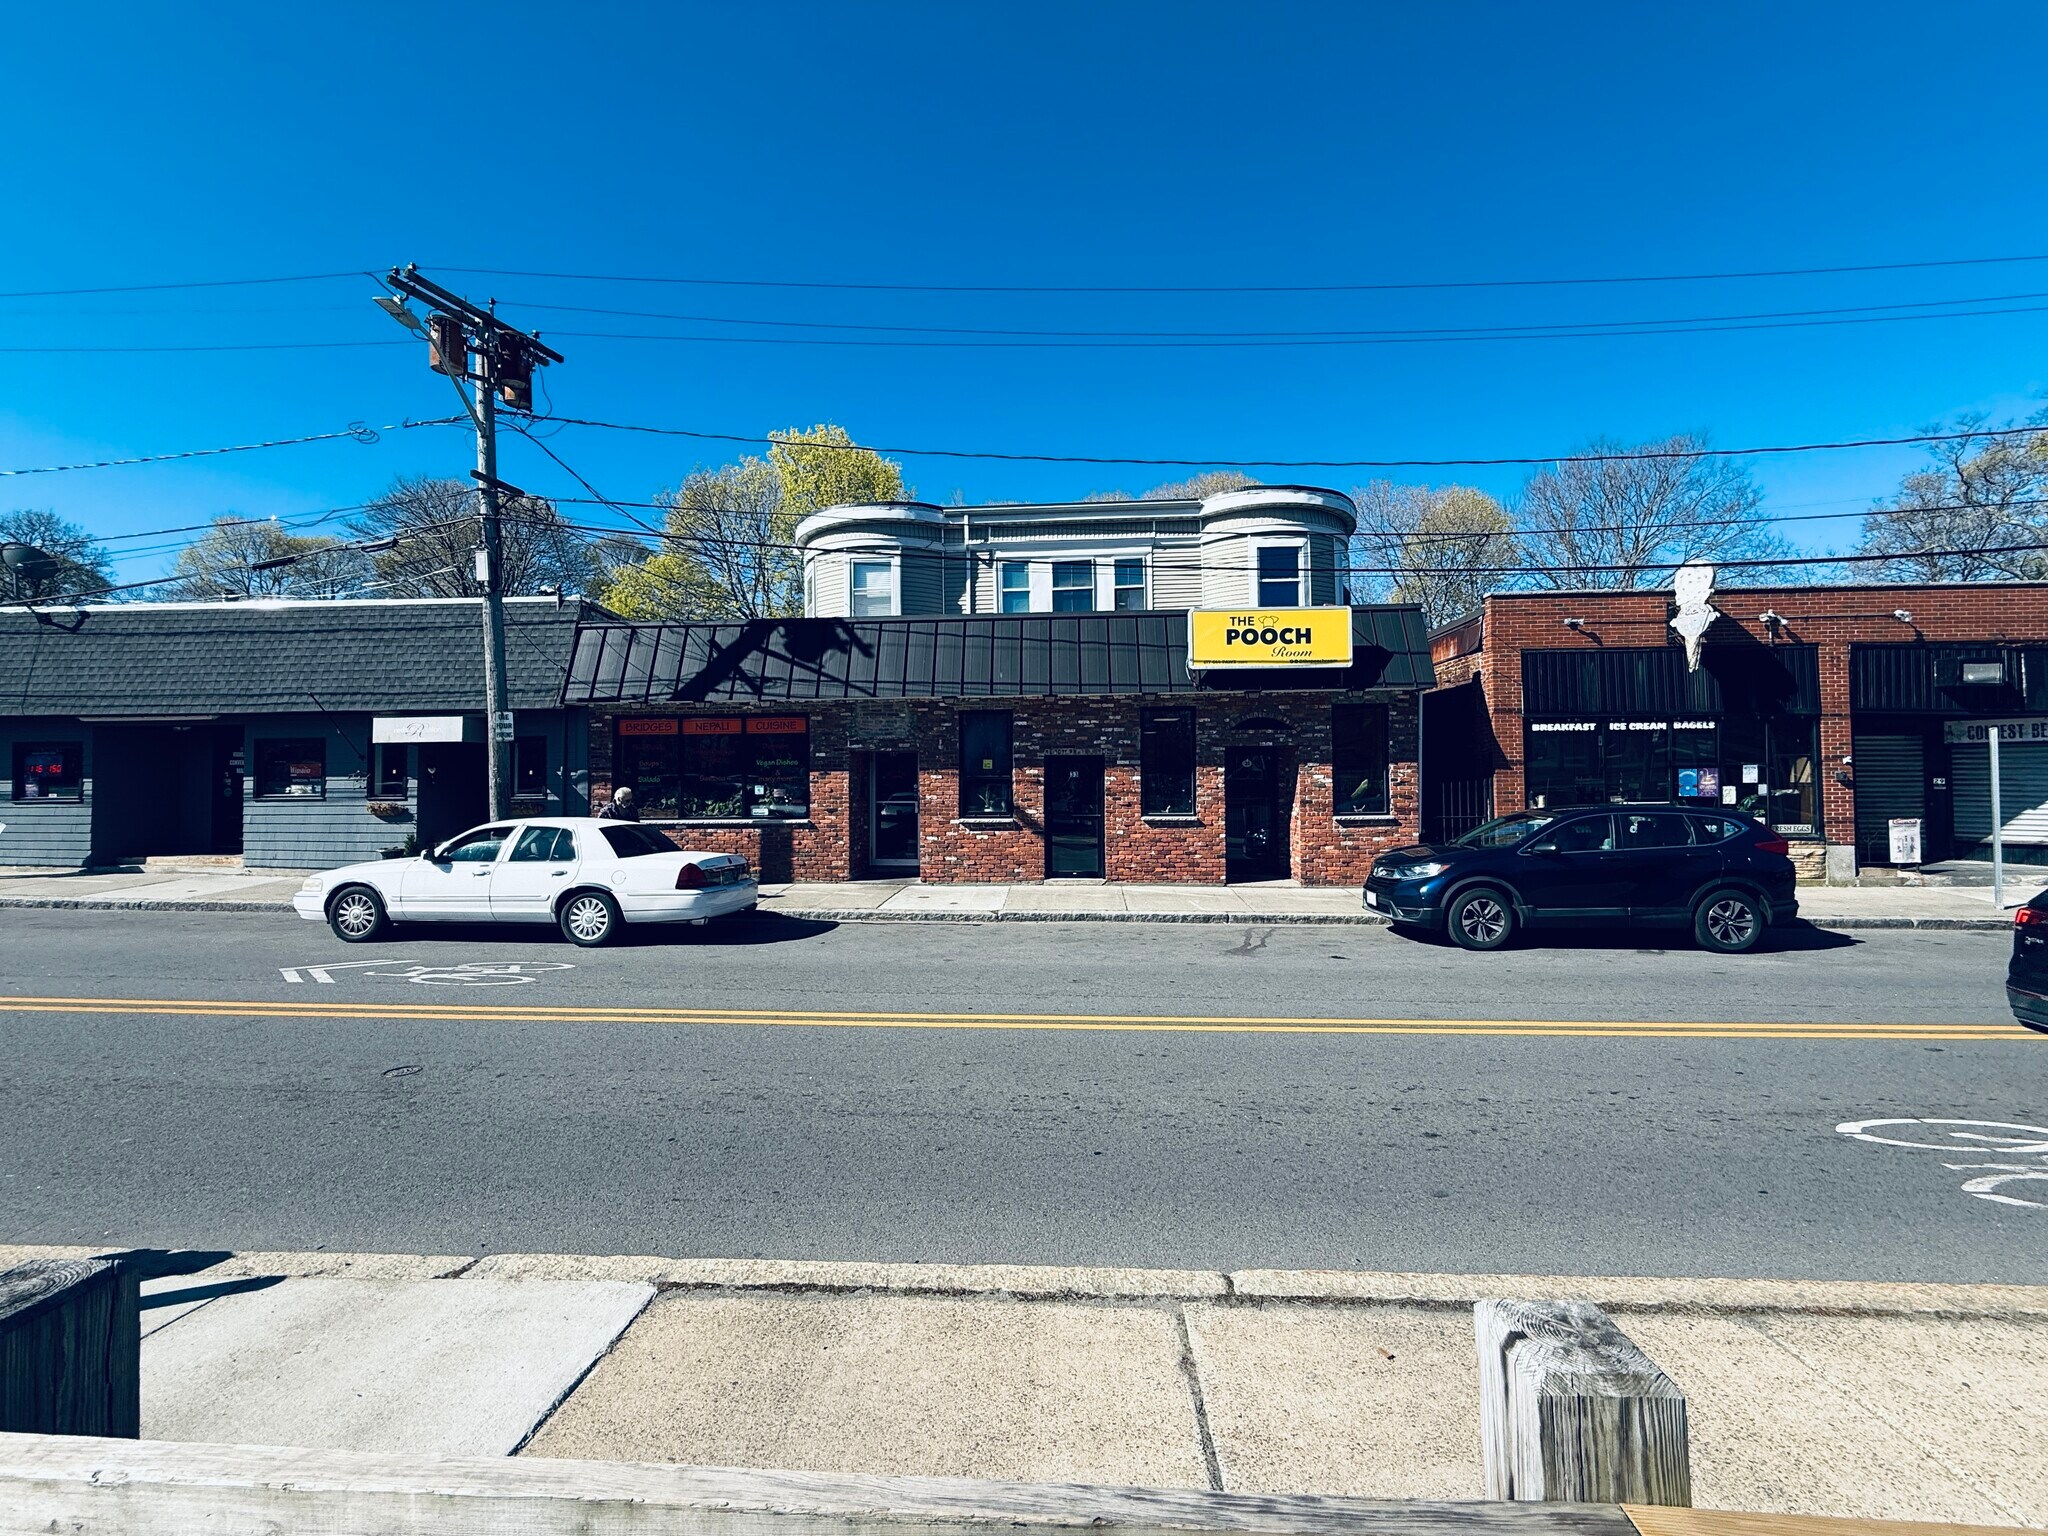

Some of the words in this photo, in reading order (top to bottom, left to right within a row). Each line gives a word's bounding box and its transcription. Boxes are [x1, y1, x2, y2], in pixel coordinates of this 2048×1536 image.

[1229, 616, 1255, 626] THE
[1226, 627, 1312, 645] POOCH
[1271, 646, 1313, 657] Room
[625, 722, 673, 732] BRIDGES
[695, 722, 730, 731] NEPALI
[755, 720, 797, 730] CUISINE
[1531, 722, 1597, 731] BREAKFAST
[1609, 722, 1627, 731] ICE
[1629, 722, 1667, 730] CREAM
[1673, 721, 1716, 730] BAGELS
[755, 759, 776, 768] Vegan
